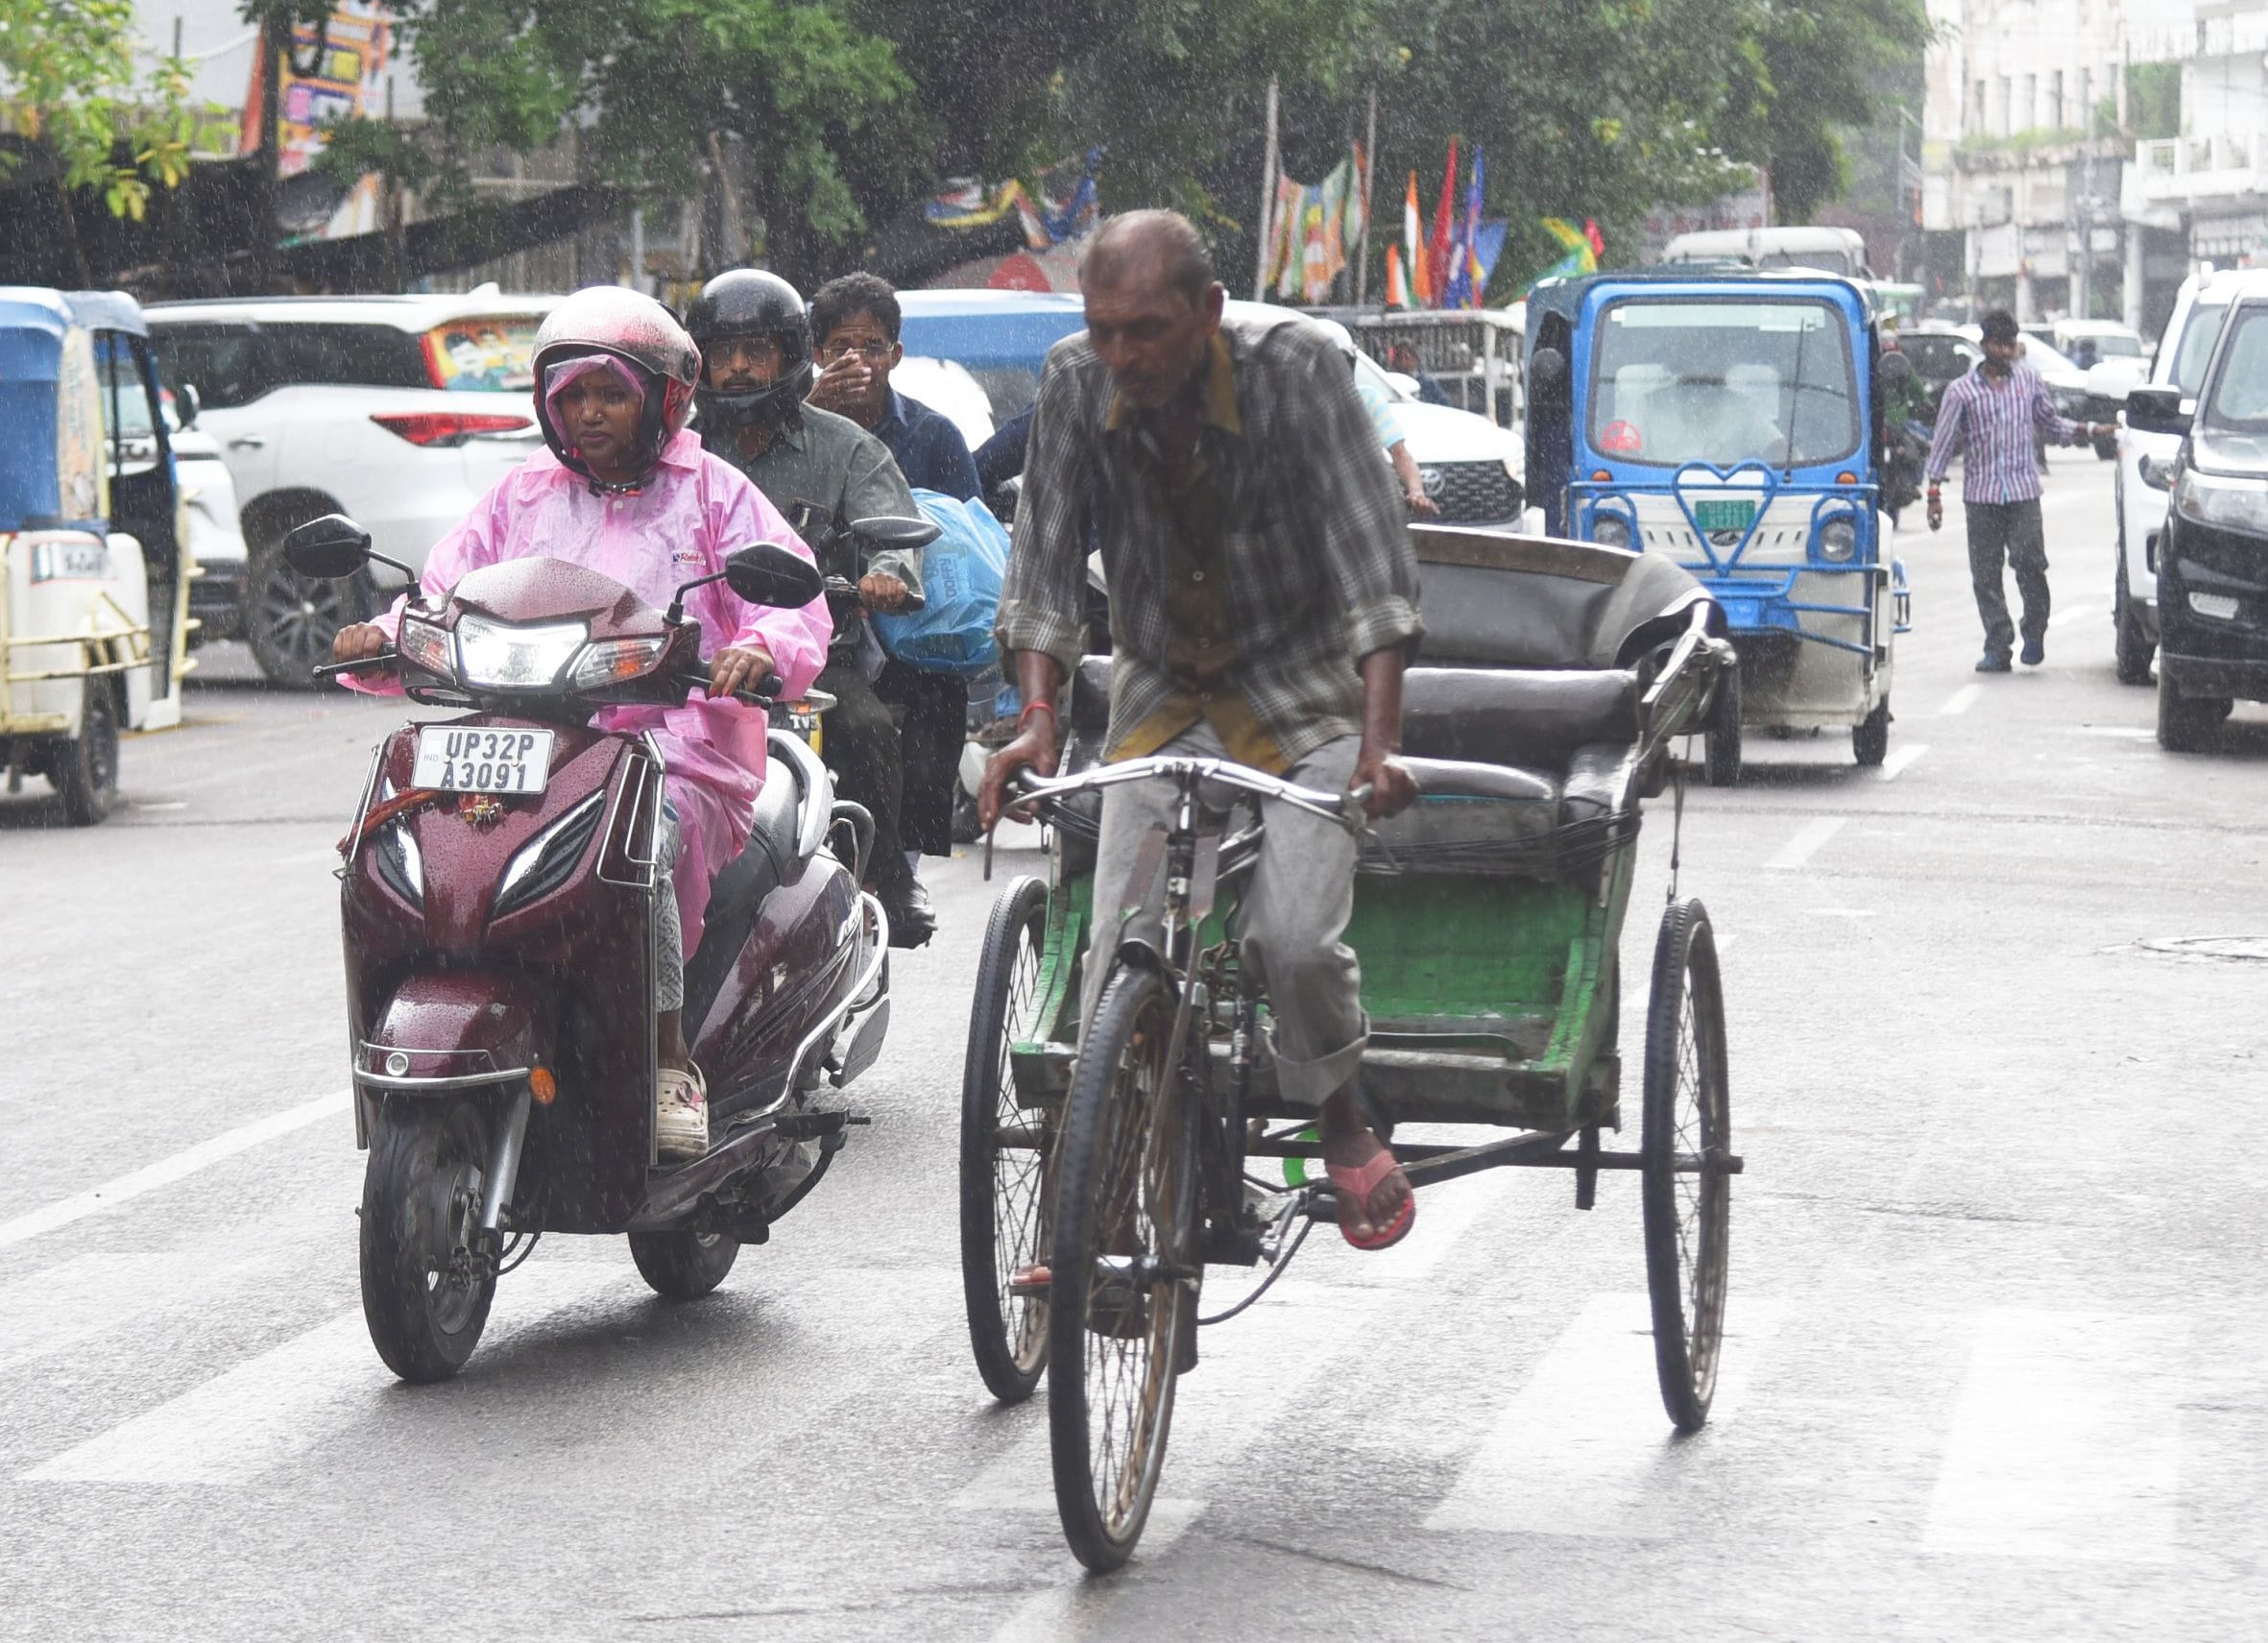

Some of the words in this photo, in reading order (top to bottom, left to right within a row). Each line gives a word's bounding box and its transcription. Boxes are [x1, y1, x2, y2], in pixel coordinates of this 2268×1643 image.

[789, 714, 818, 731] TVS
[446, 732, 534, 761] UP32P
[440, 761, 526, 789] A3091
